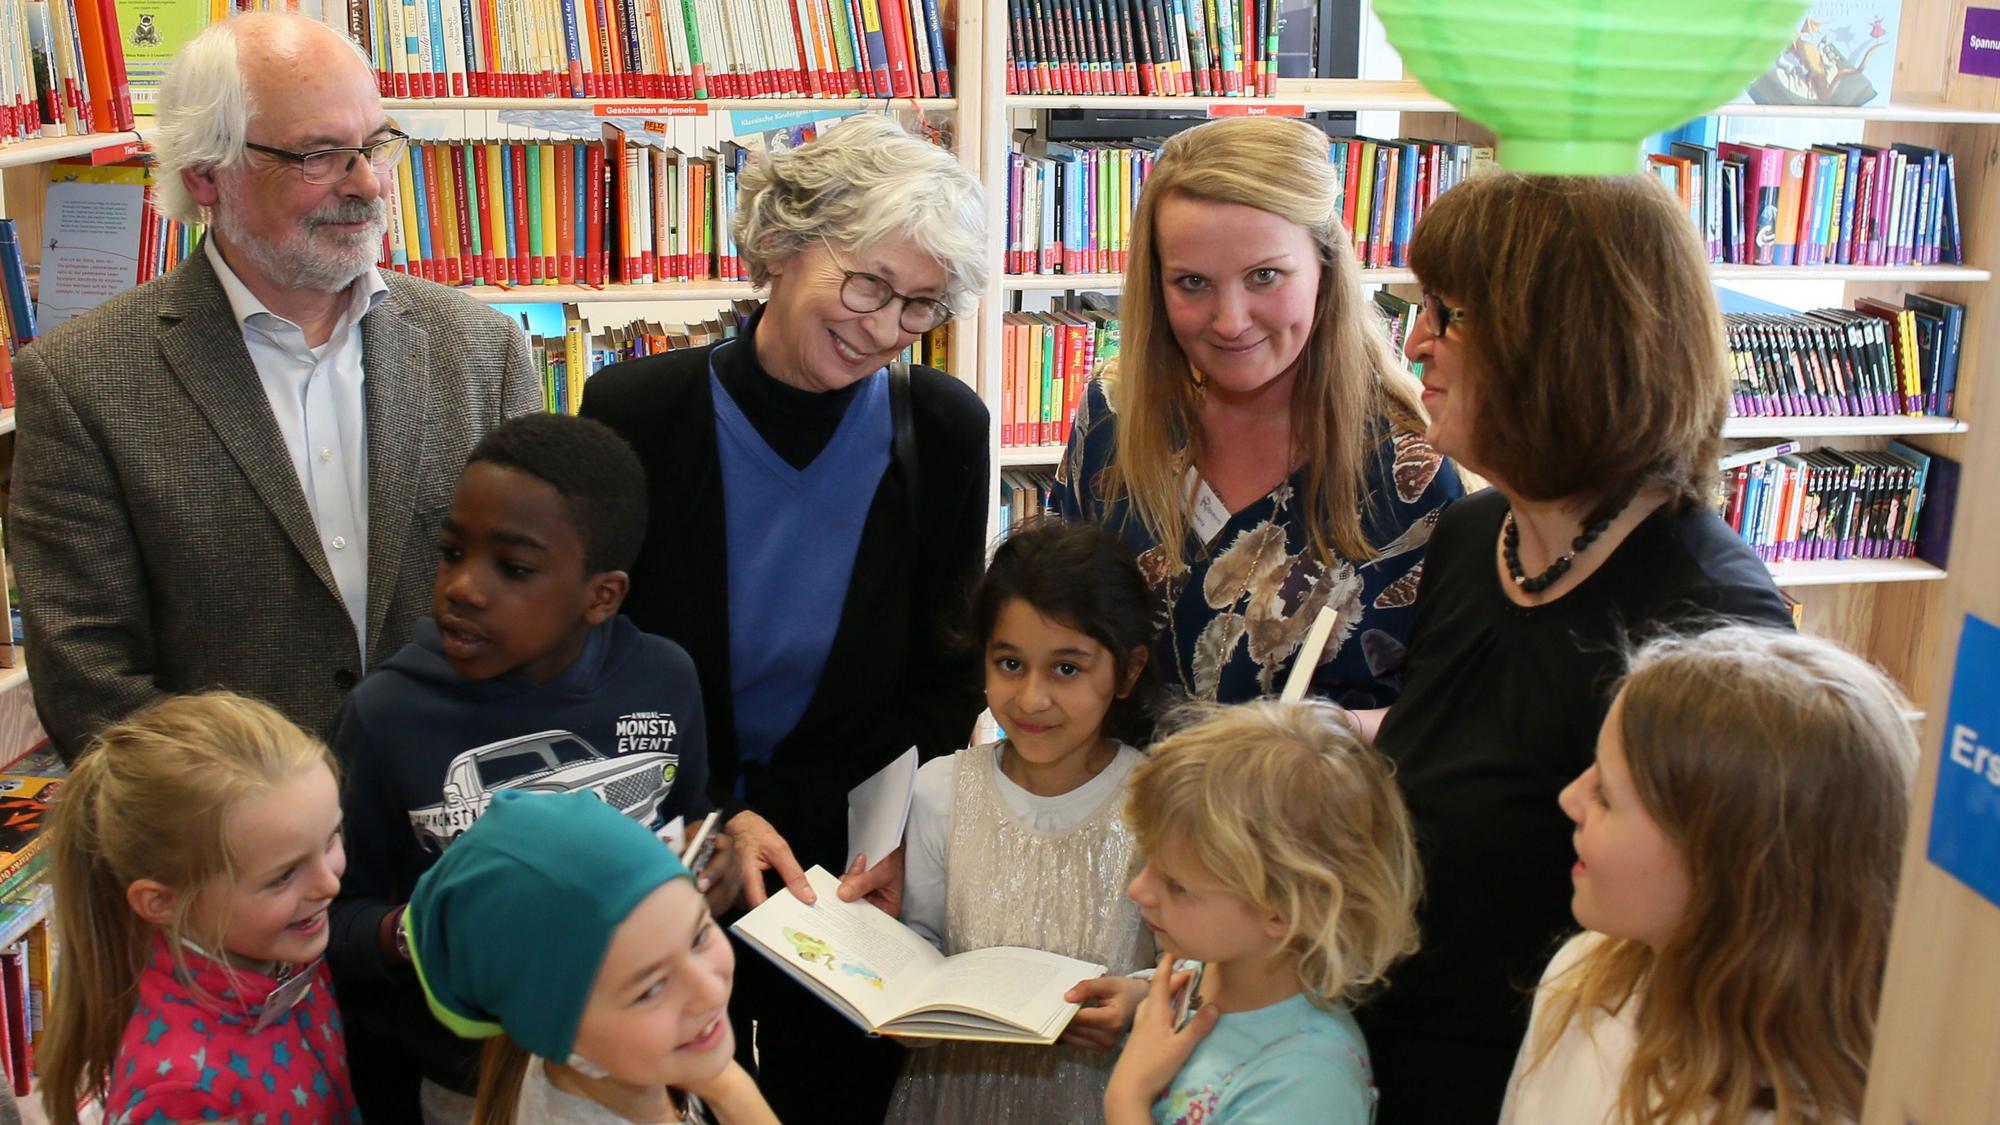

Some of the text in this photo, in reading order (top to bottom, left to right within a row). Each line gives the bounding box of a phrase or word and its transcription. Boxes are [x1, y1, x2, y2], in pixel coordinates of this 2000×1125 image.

[606, 106, 697, 116] Geschichten allgemein
[1247, 107, 1267, 116] Sport
[616, 719, 677, 737] MONSTA
[618, 735, 673, 753] EVENT
